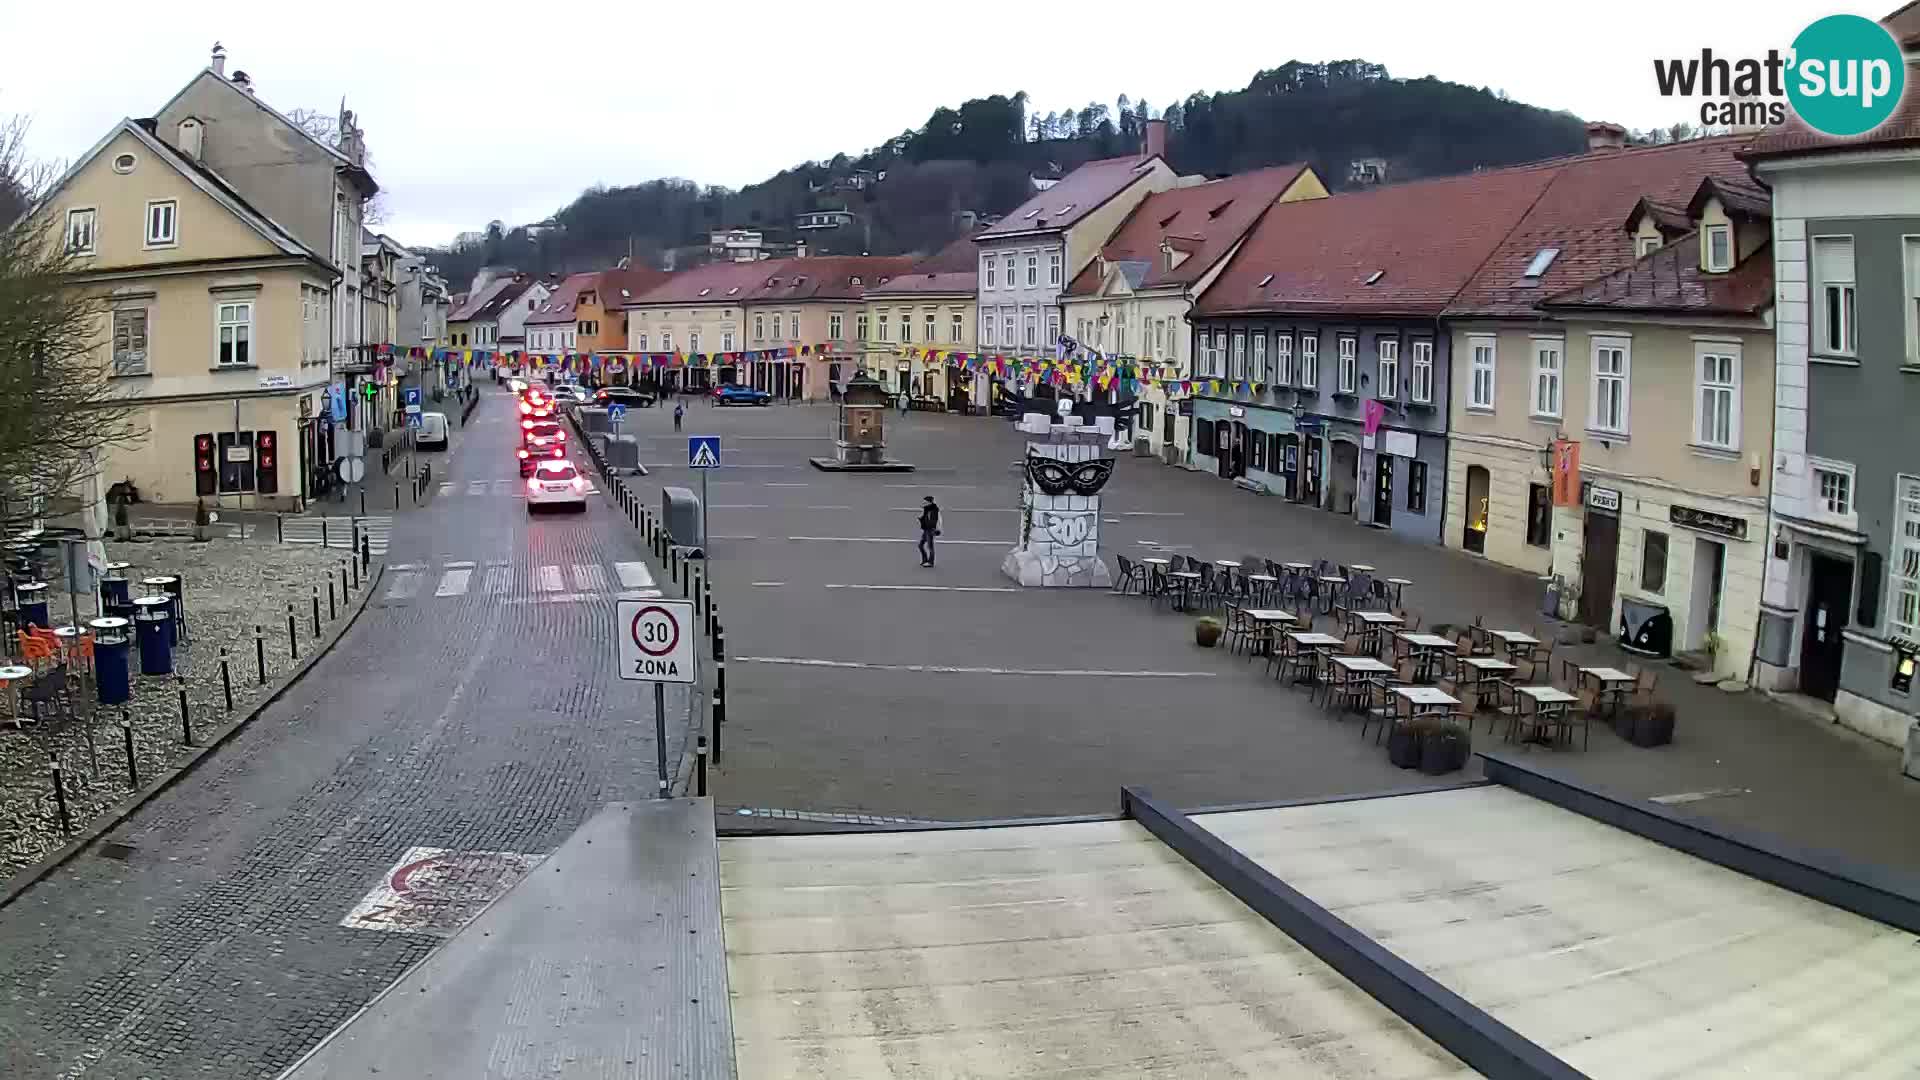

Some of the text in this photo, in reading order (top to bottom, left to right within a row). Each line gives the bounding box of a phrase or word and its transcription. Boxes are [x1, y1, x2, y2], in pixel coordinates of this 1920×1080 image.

[409, 391, 417, 402] P
[644, 621, 668, 643] 30
[634, 659, 679, 677] ZONA
